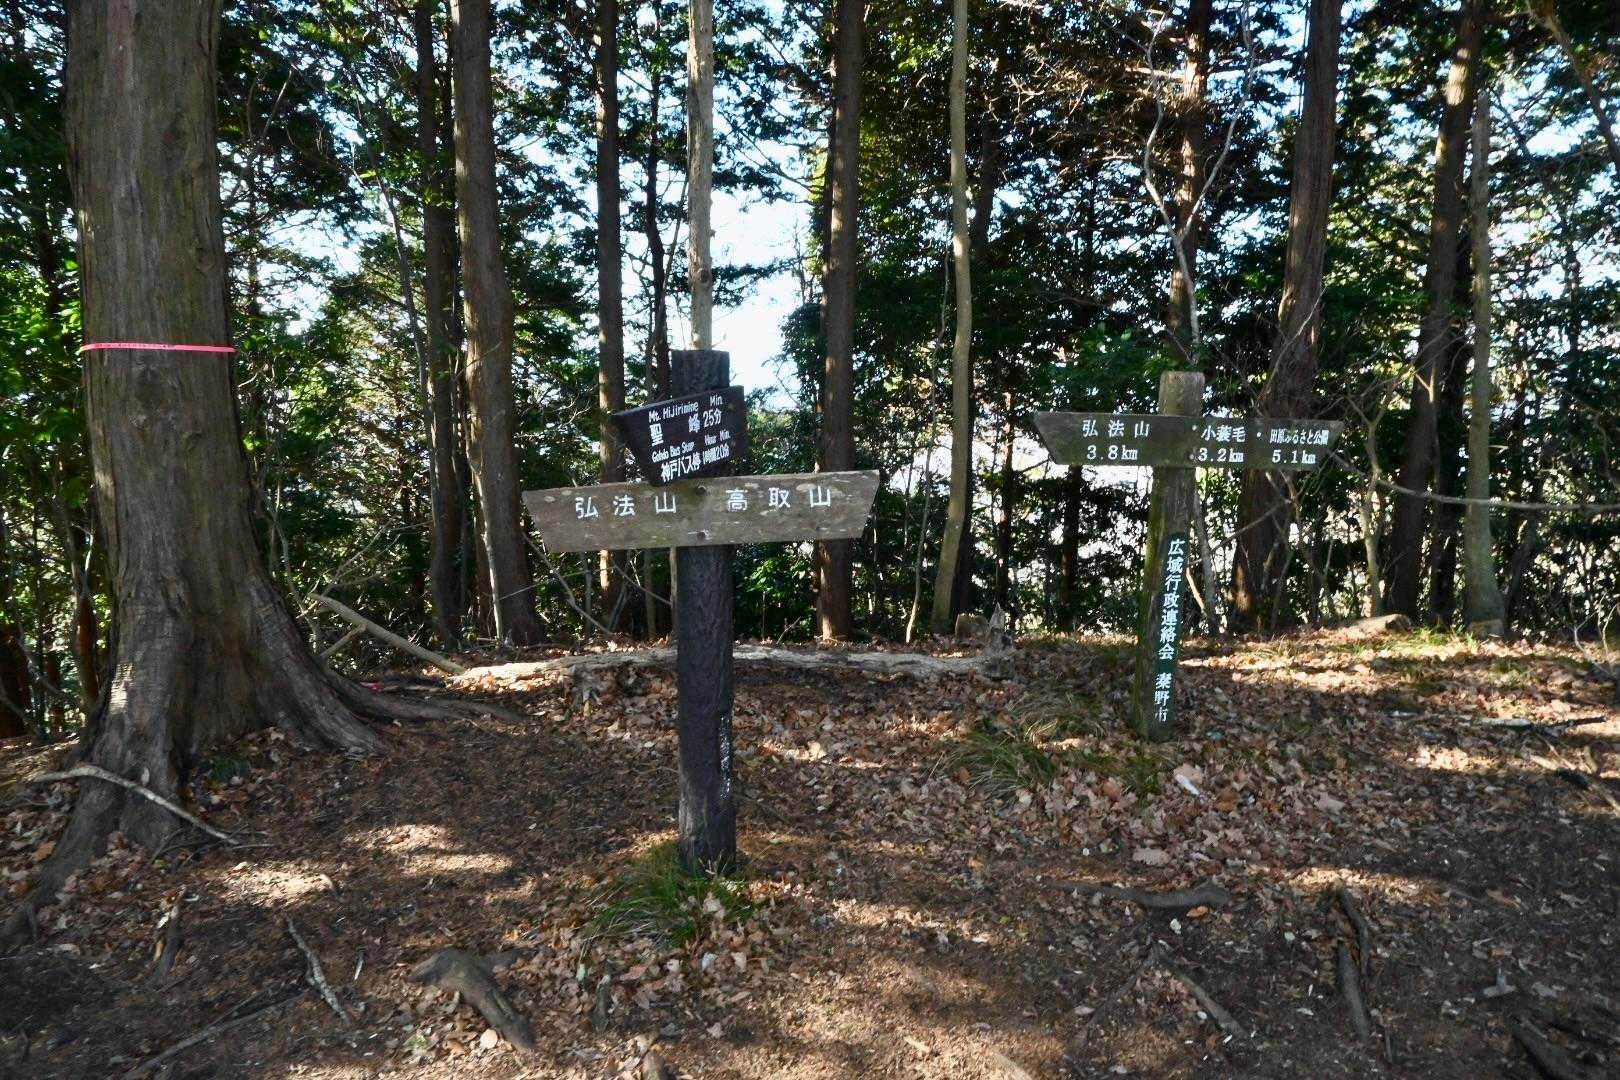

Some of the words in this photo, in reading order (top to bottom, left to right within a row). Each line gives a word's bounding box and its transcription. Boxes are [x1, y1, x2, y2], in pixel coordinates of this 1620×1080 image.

[1082, 419, 1150, 438] 弘法山
[574, 491, 677, 520] 弘法山
[726, 485, 832, 512] 高取山
[1158, 538, 1186, 660] 広域行政連絡会
